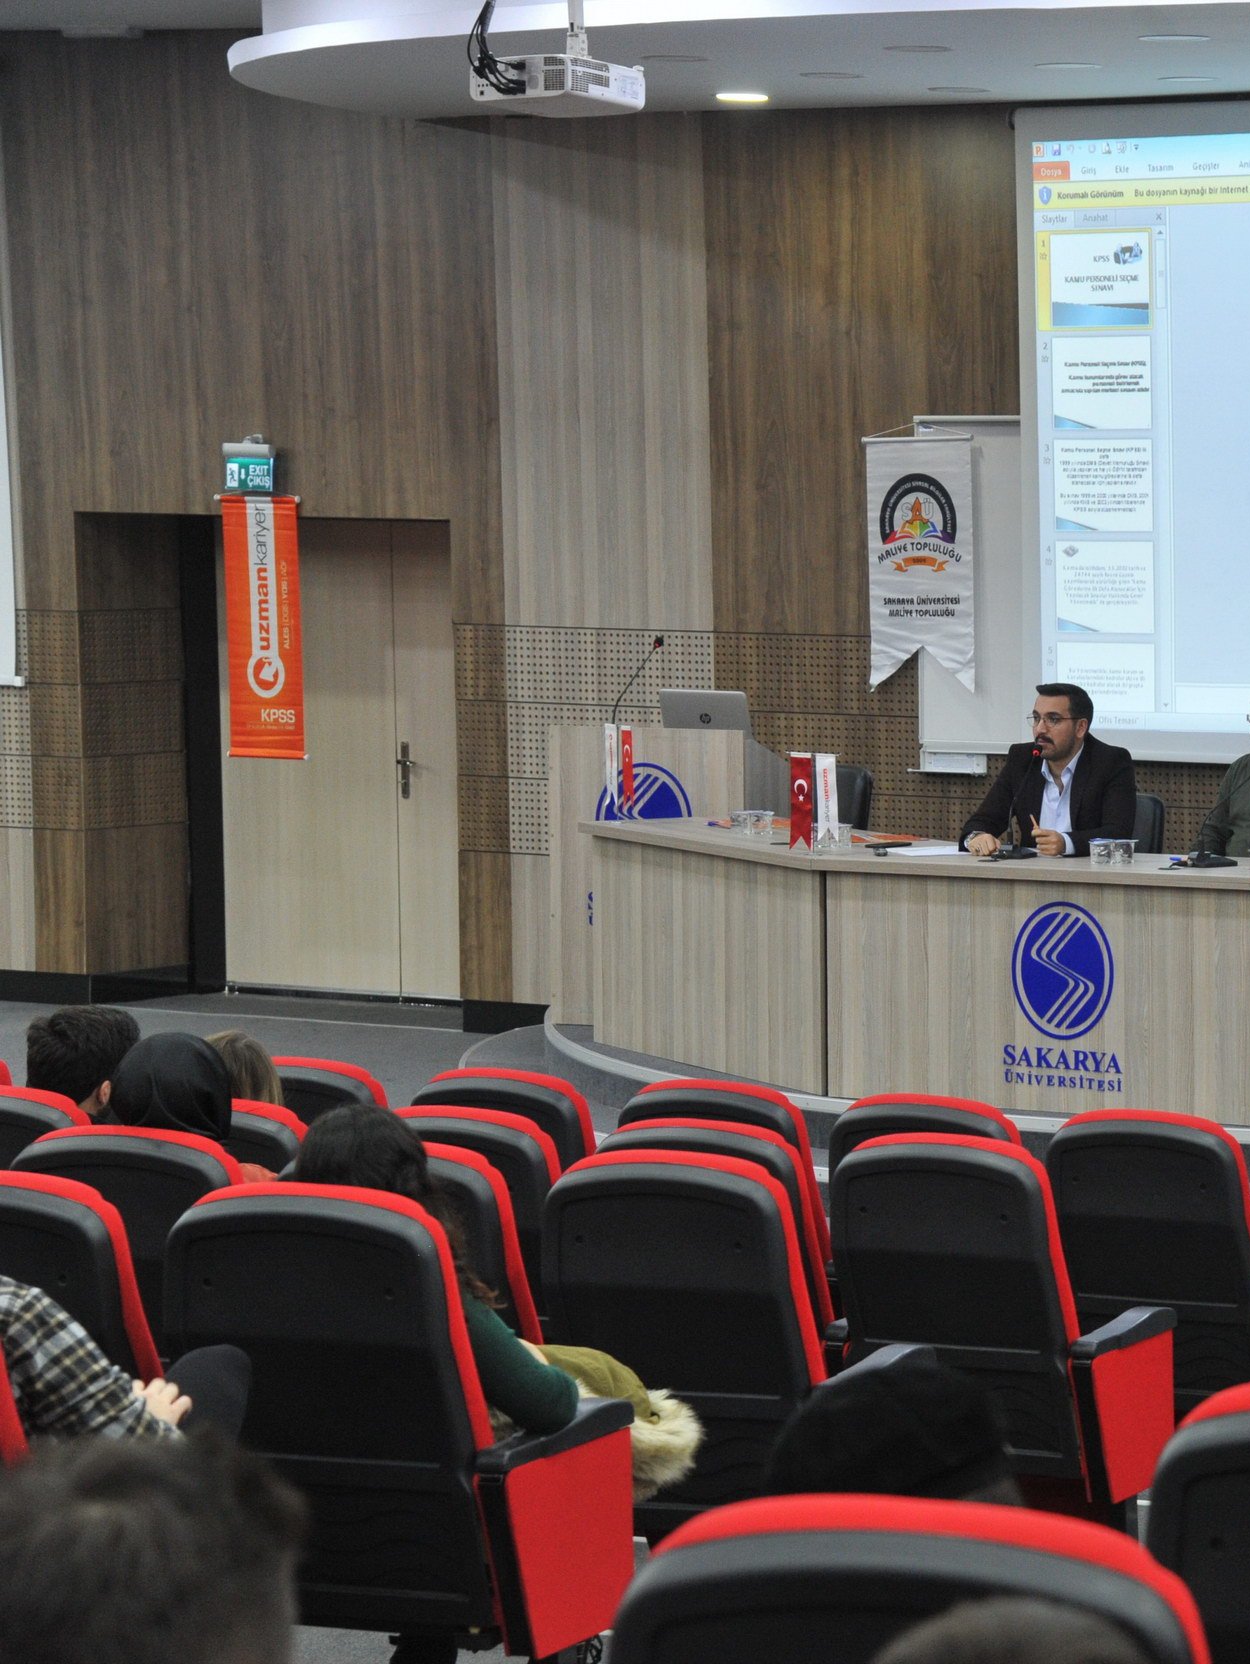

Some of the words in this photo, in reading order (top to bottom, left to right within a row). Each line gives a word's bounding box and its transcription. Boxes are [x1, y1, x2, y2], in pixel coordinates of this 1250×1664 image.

[1040, 168, 1062, 177] Dosya
[1115, 165, 1130, 174] Ekle
[1148, 164, 1174, 172] Tasarım
[1057, 190, 1089, 200] Korumalı
[1090, 190, 1124, 199] Görünüm
[1134, 188, 1143, 198] Bu
[1145, 187, 1178, 198] dosyanın
[1179, 186, 1207, 197] kaynağı
[1208, 186, 1218, 194] bir
[1041, 214, 1068, 225] Slaytlar
[1093, 255, 1110, 263] KPSS
[1064, 275, 1085, 284] KAMU
[249, 464, 269, 476] EXIT
[247, 475, 270, 489] ÇIKIŞ
[878, 542, 909, 564] MALİYE
[910, 542, 962, 562] TOPLULUĞU
[253, 504, 271, 651] uzmankariyer
[883, 597, 914, 605] SAKARYA
[916, 594, 960, 605] ÜNİVERSİTESİ
[888, 606, 913, 617] MALİYE
[915, 606, 955, 617] TOPLULUĞU
[261, 708, 296, 723] KPSS
[1003, 1043, 1123, 1074] SAKARYA
[1004, 1068, 1122, 1092] ÜNİVERSİTESİ
